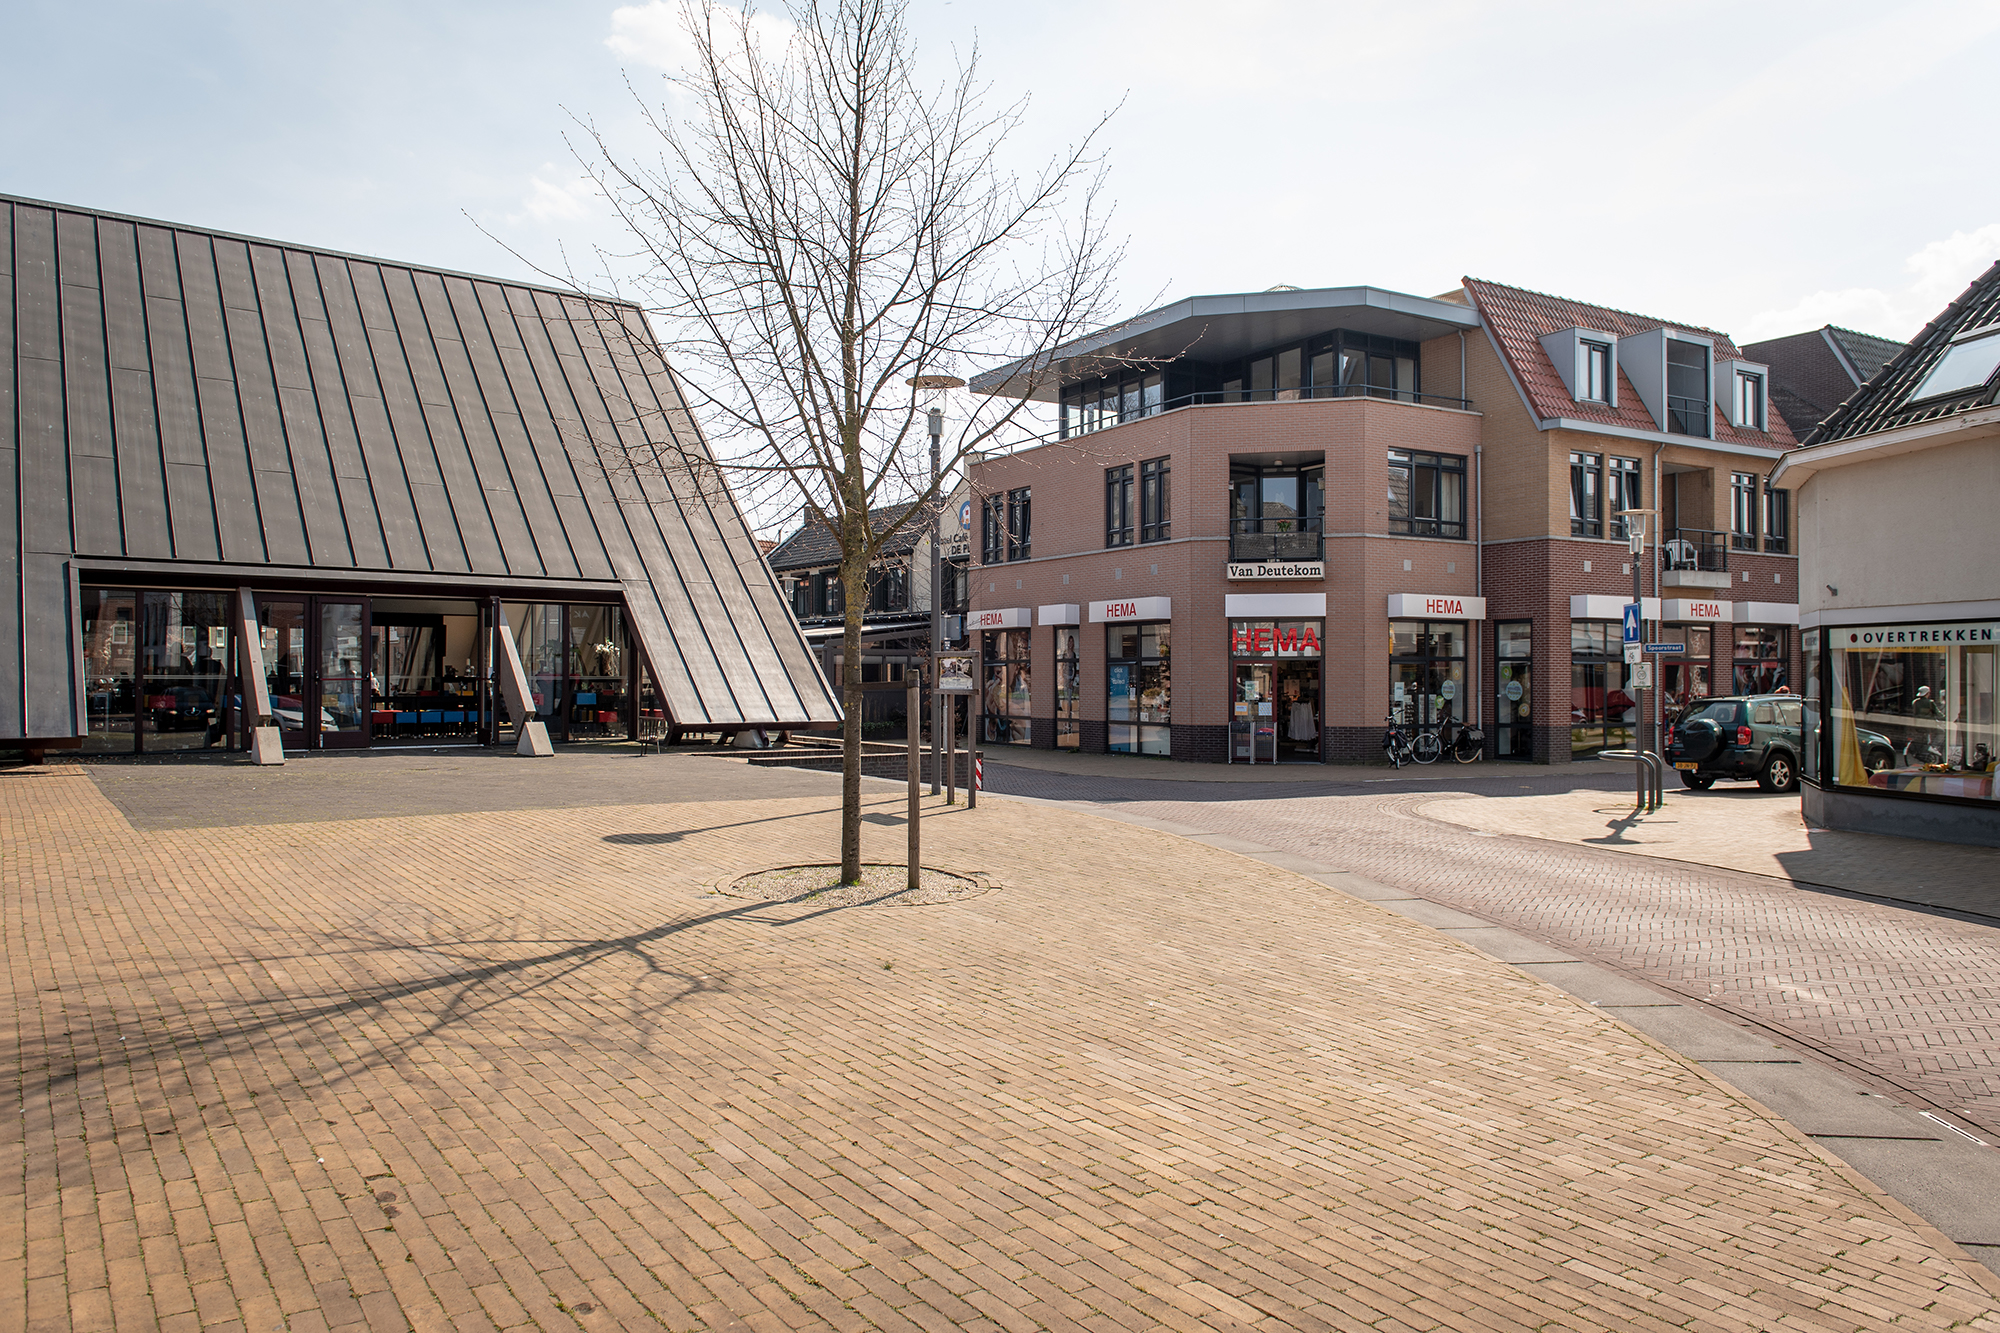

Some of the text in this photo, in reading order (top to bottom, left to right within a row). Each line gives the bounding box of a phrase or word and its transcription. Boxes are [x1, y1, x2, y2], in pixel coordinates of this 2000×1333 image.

[951, 544, 961, 554] DE
[1230, 565, 1321, 576] Van Deutekom
[1106, 602, 1137, 617] HEMA
[1426, 599, 1463, 614] HEMA
[1690, 603, 1720, 617] HEMA
[980, 613, 1003, 625] HEMA
[1232, 627, 1321, 652] HEMA
[1863, 628, 1992, 644] OVERTREKKEN
